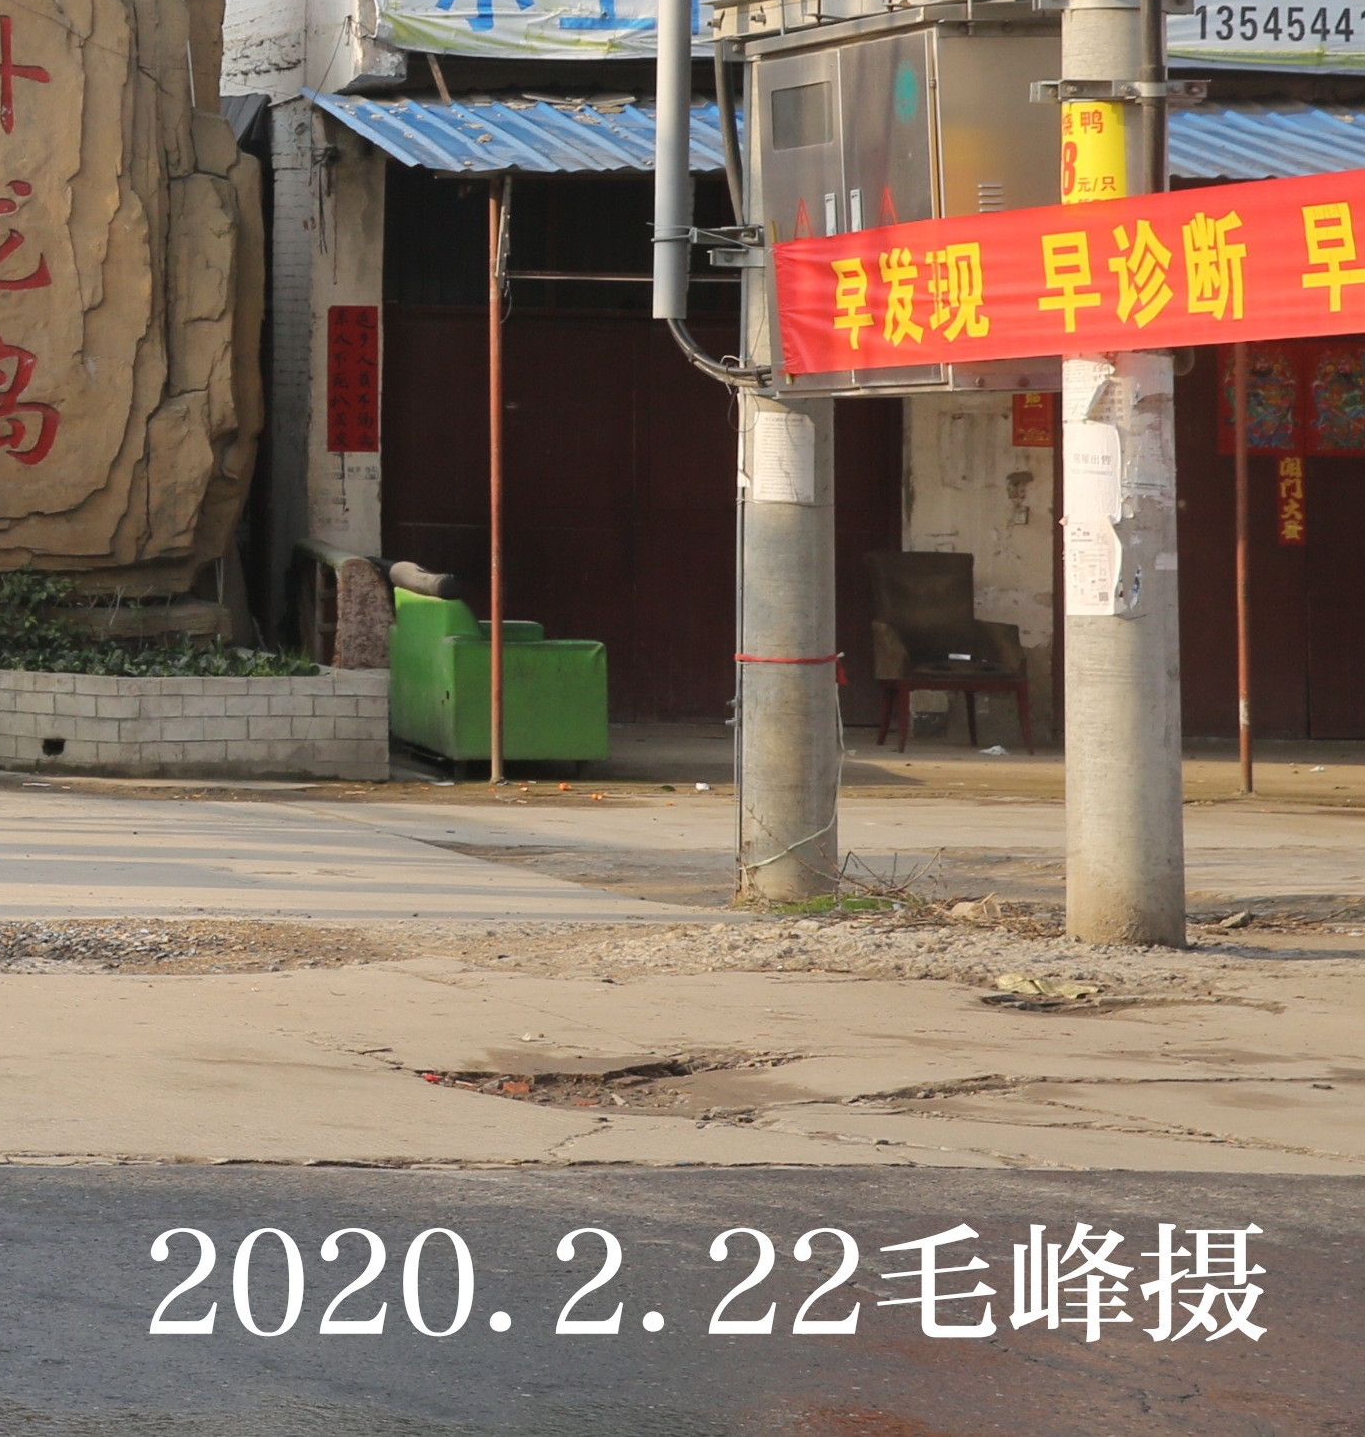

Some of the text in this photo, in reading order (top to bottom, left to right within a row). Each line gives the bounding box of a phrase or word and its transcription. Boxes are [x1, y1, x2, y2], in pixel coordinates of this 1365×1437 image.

[831, 202, 1365, 350] 早发现 早诊断 早
